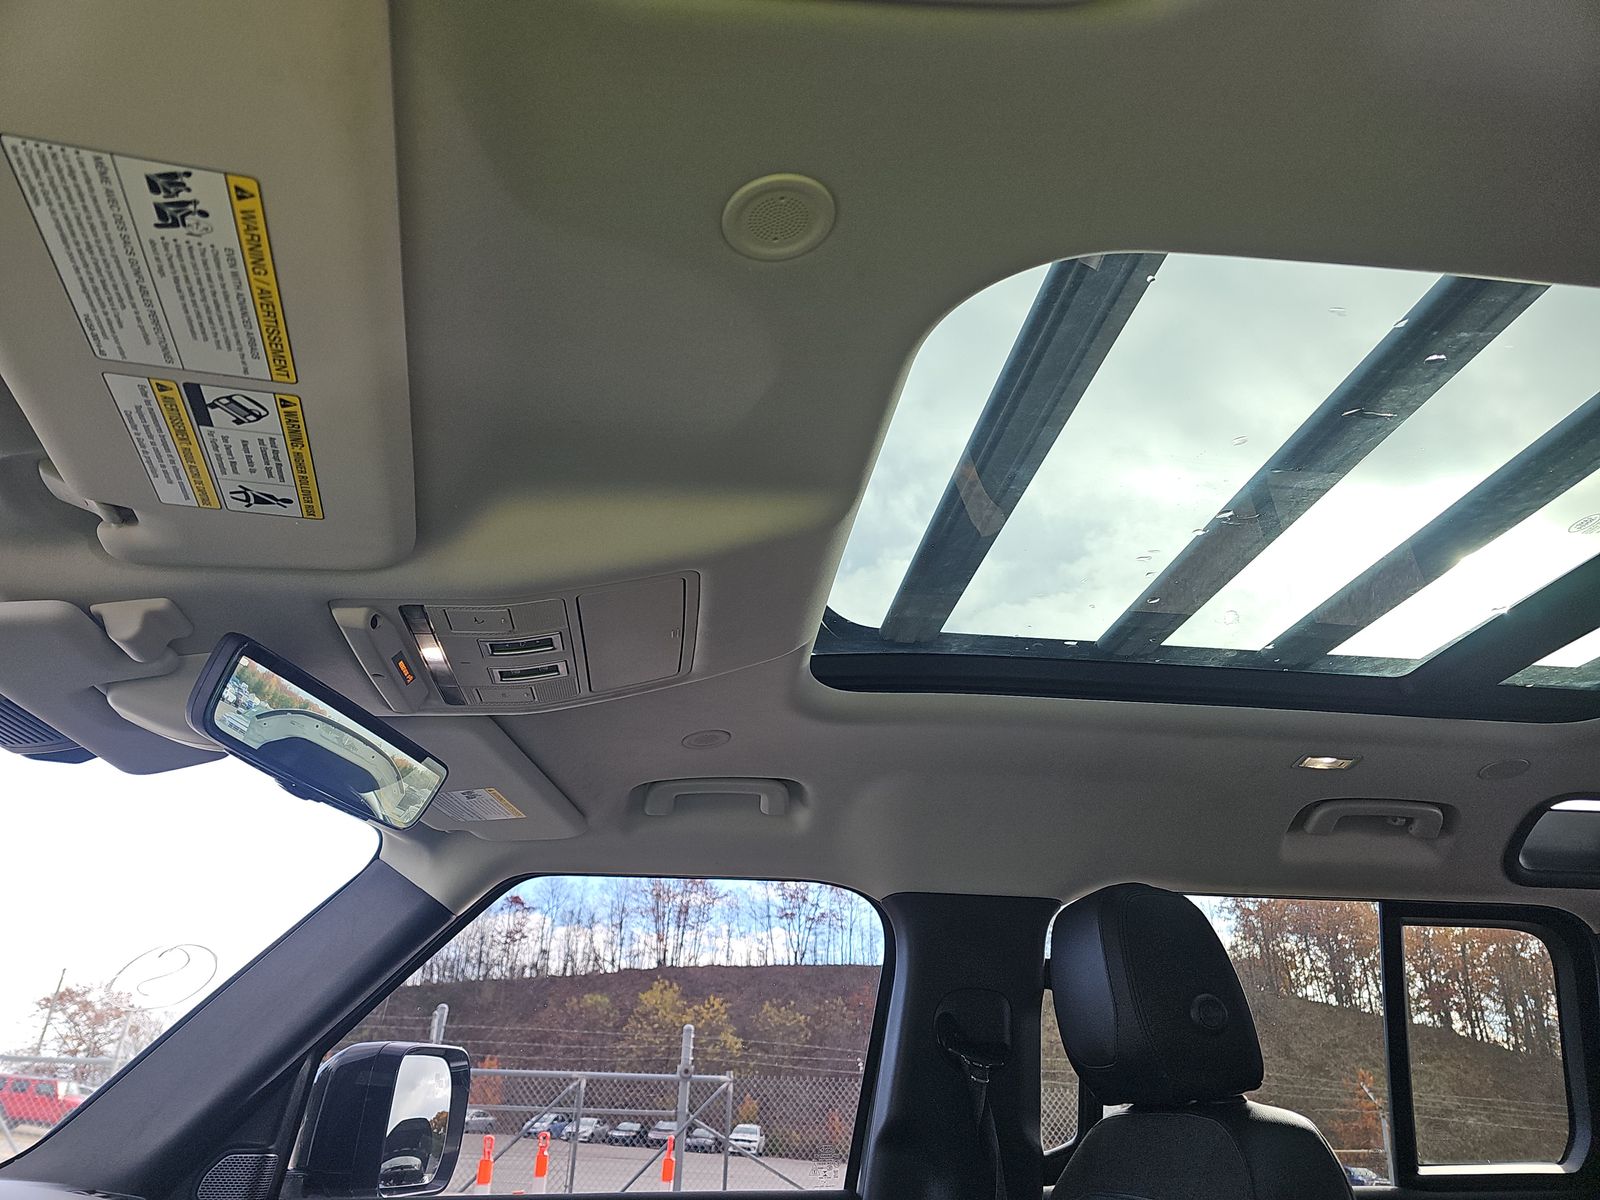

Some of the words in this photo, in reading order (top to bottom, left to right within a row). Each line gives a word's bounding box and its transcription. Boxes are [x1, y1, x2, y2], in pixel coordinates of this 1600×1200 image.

[224, 247, 238, 270] EVEN
[230, 271, 243, 291] WITH
[239, 208, 268, 277] WARNING
[257, 287, 289, 379] AVERTISSEMENT
[235, 292, 253, 330] ADVANCED
[283, 410, 304, 451] WARNING:
[293, 452, 306, 474] HIGHER
[298, 475, 313, 504] ROLLOVER
[305, 505, 315, 517] RISK
